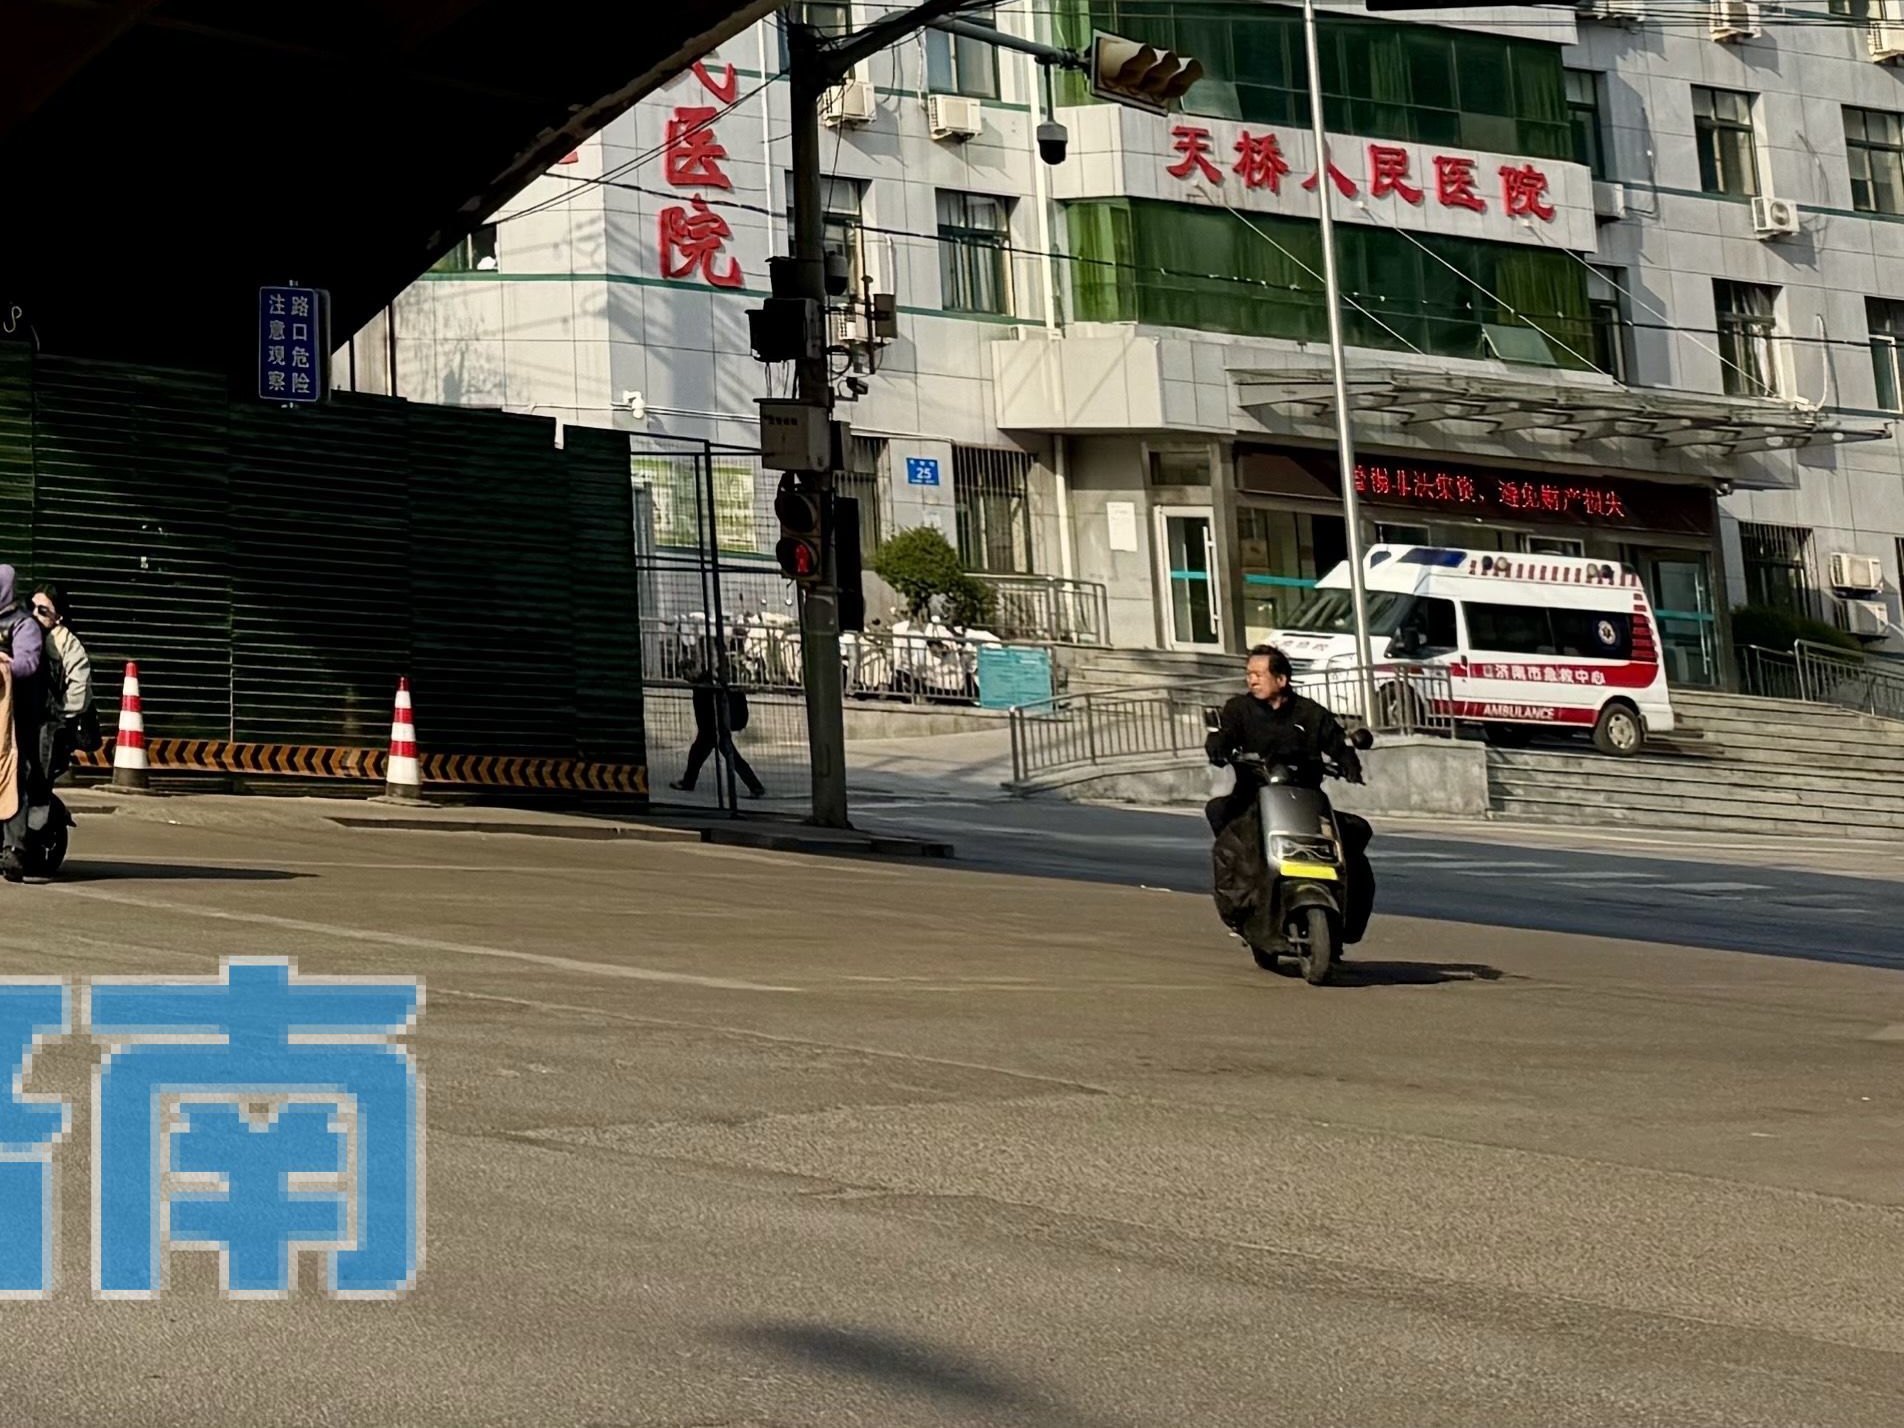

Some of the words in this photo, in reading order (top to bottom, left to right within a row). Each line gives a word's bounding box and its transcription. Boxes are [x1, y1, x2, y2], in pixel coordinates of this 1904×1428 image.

[1165, 125, 1555, 222] 天桥人民医院
[268, 293, 287, 391] 注意观察
[291, 295, 311, 394] 路口危险
[916, 467, 932, 479] 25
[1483, 704, 1555, 719] AMBULANCE
